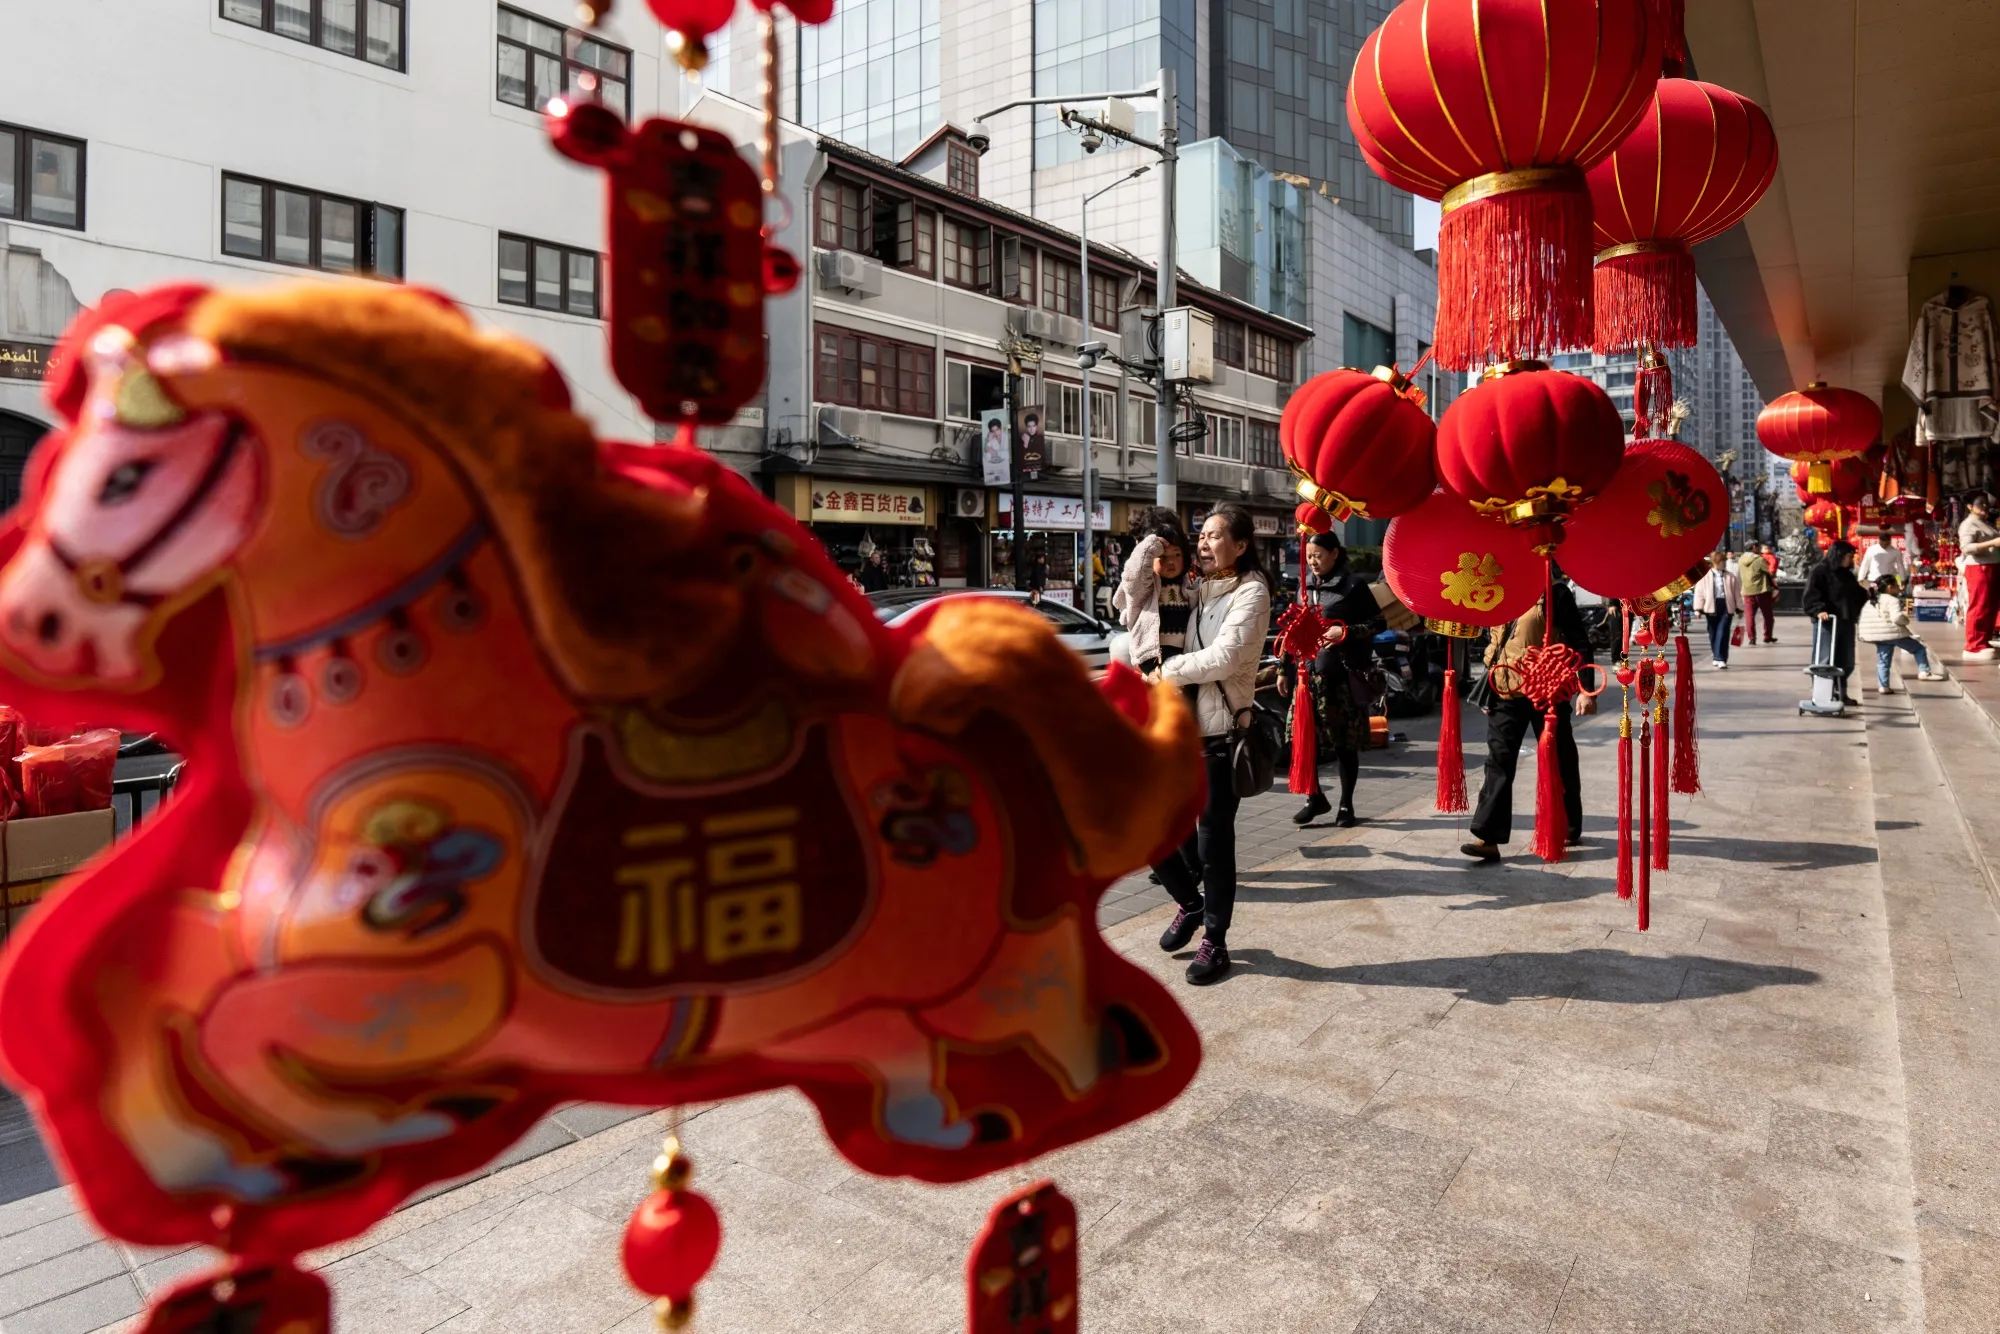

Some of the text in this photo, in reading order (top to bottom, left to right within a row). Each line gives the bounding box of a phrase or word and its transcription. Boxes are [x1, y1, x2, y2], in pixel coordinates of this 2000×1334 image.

[826, 490, 907, 513] 金鑫百货店
[1062, 503, 1105, 520] 工厂销
[1647, 470, 1711, 538] 福
[1440, 552, 1505, 611] 福
[615, 806, 804, 975] 福
